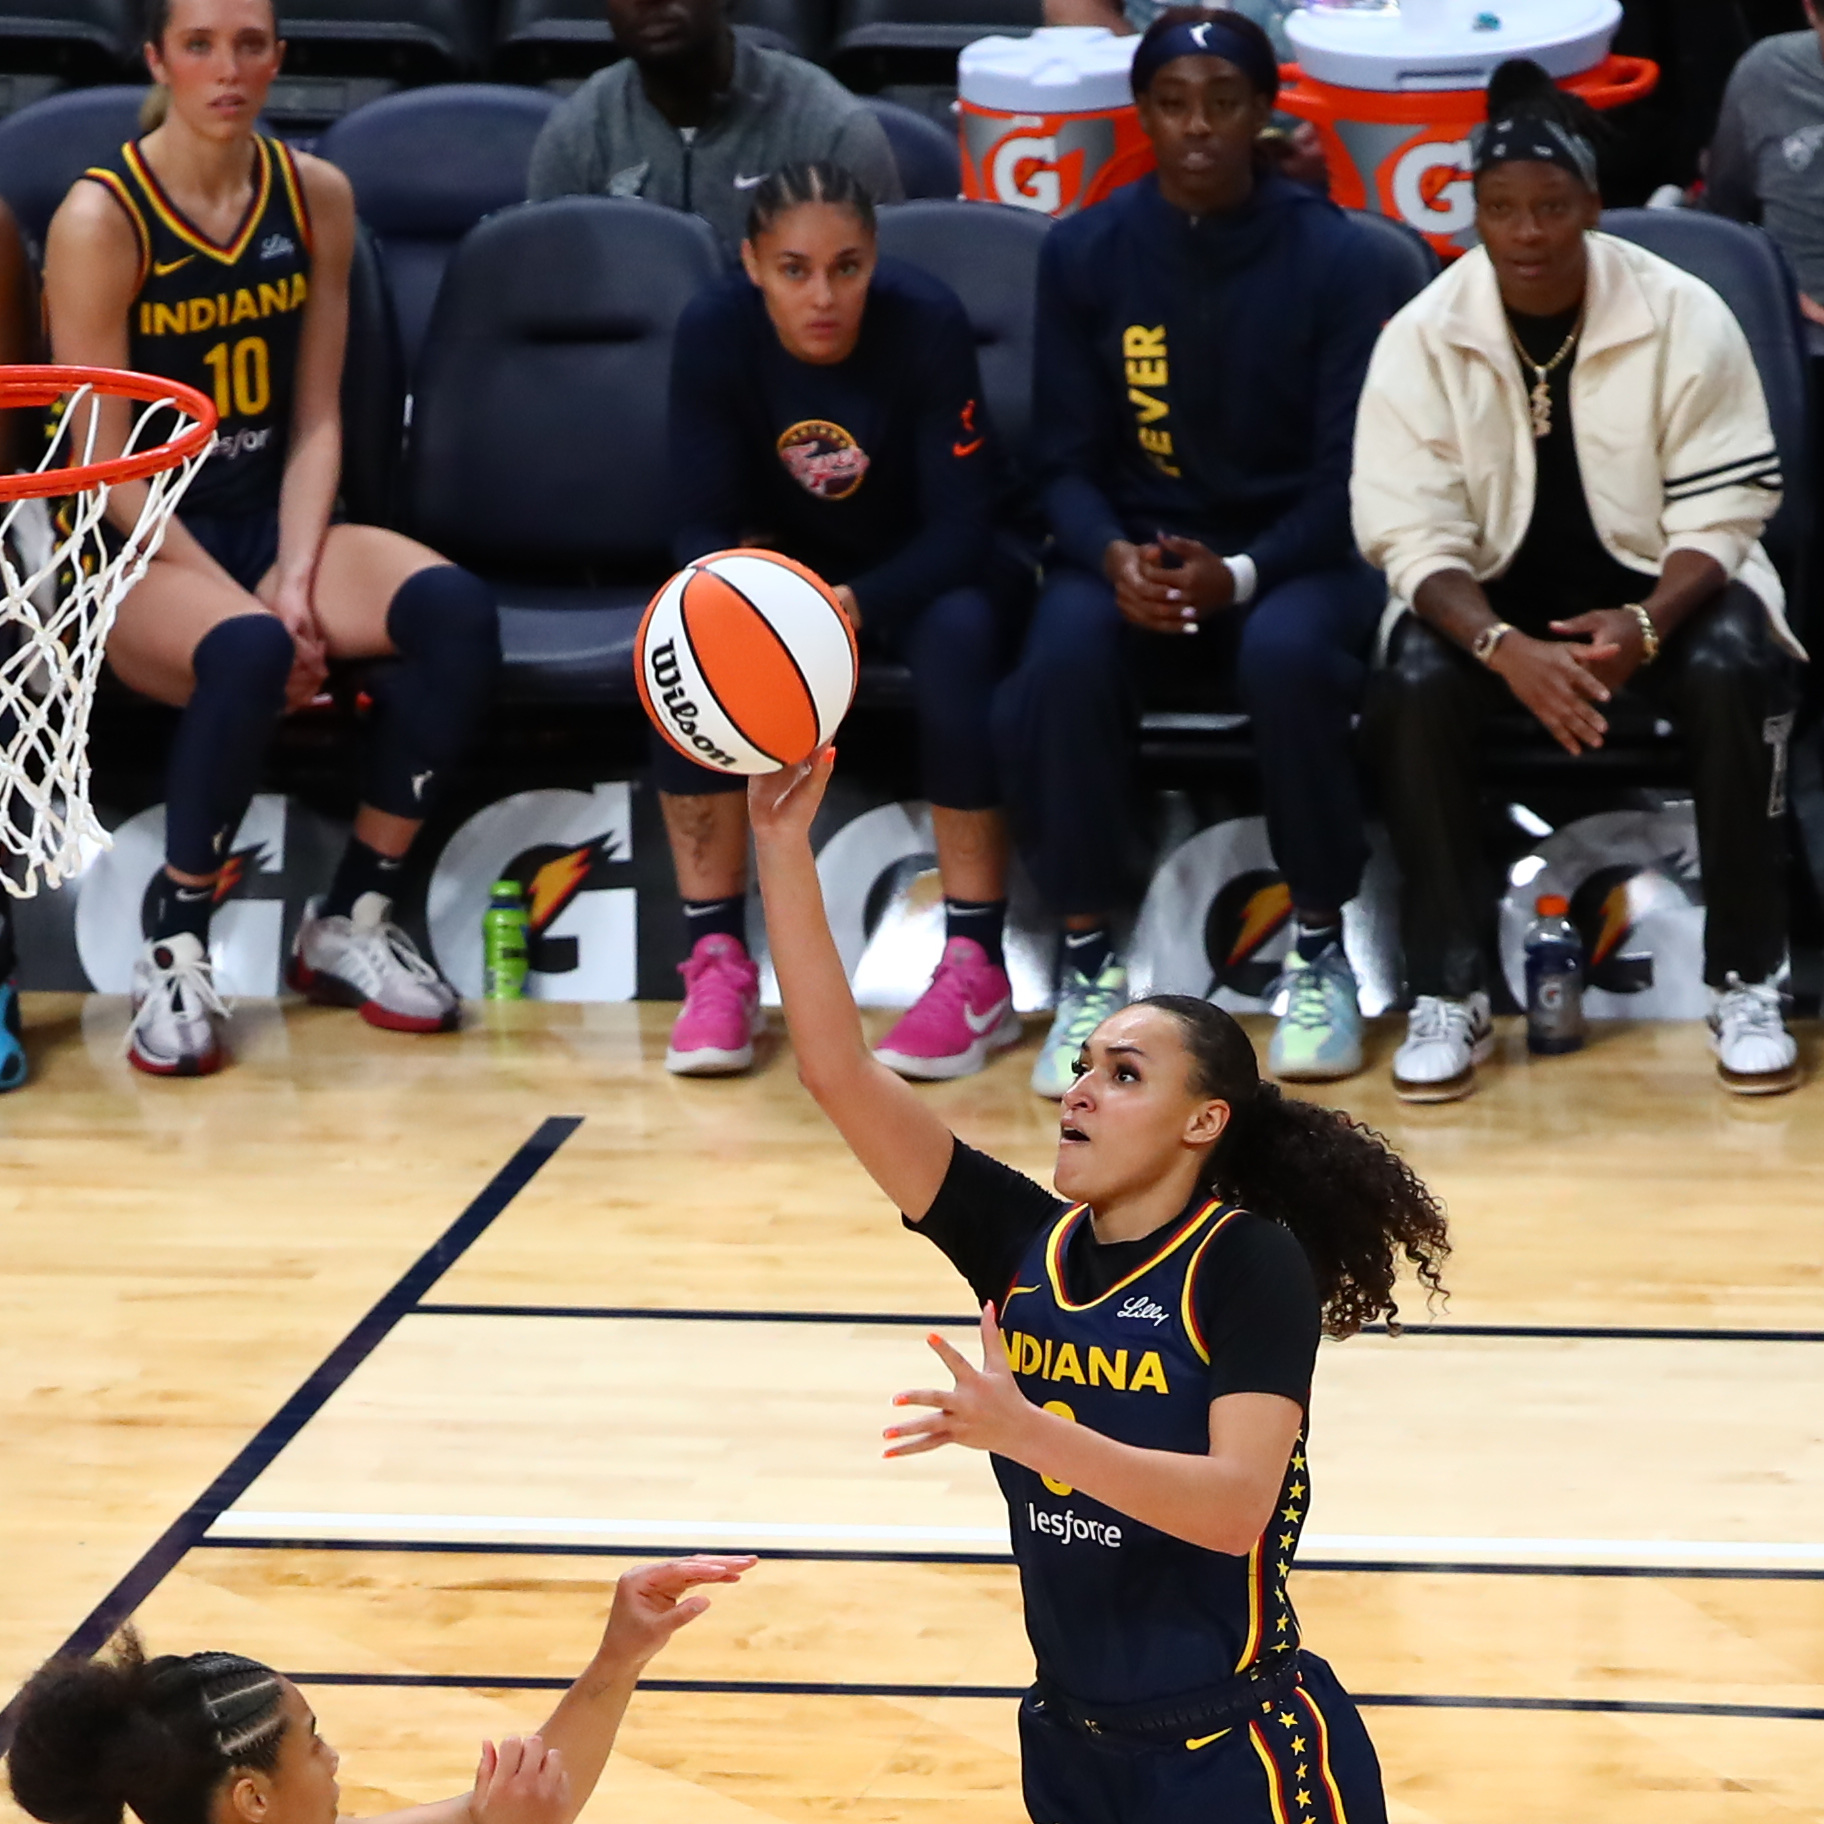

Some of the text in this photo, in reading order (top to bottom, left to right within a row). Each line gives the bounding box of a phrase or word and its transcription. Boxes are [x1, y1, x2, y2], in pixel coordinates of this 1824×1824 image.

[992, 137, 1061, 215] G
[1392, 141, 1475, 234] G
[139, 272, 307, 336] INDIANA
[203, 336, 271, 418] 10
[651, 636, 738, 768] Wilson
[426, 781, 637, 1001] G
[1117, 1296, 1169, 1326] Lilly
[1000, 1327, 1169, 1394] NDIANA
[1027, 1502, 1122, 1548] lesforce
